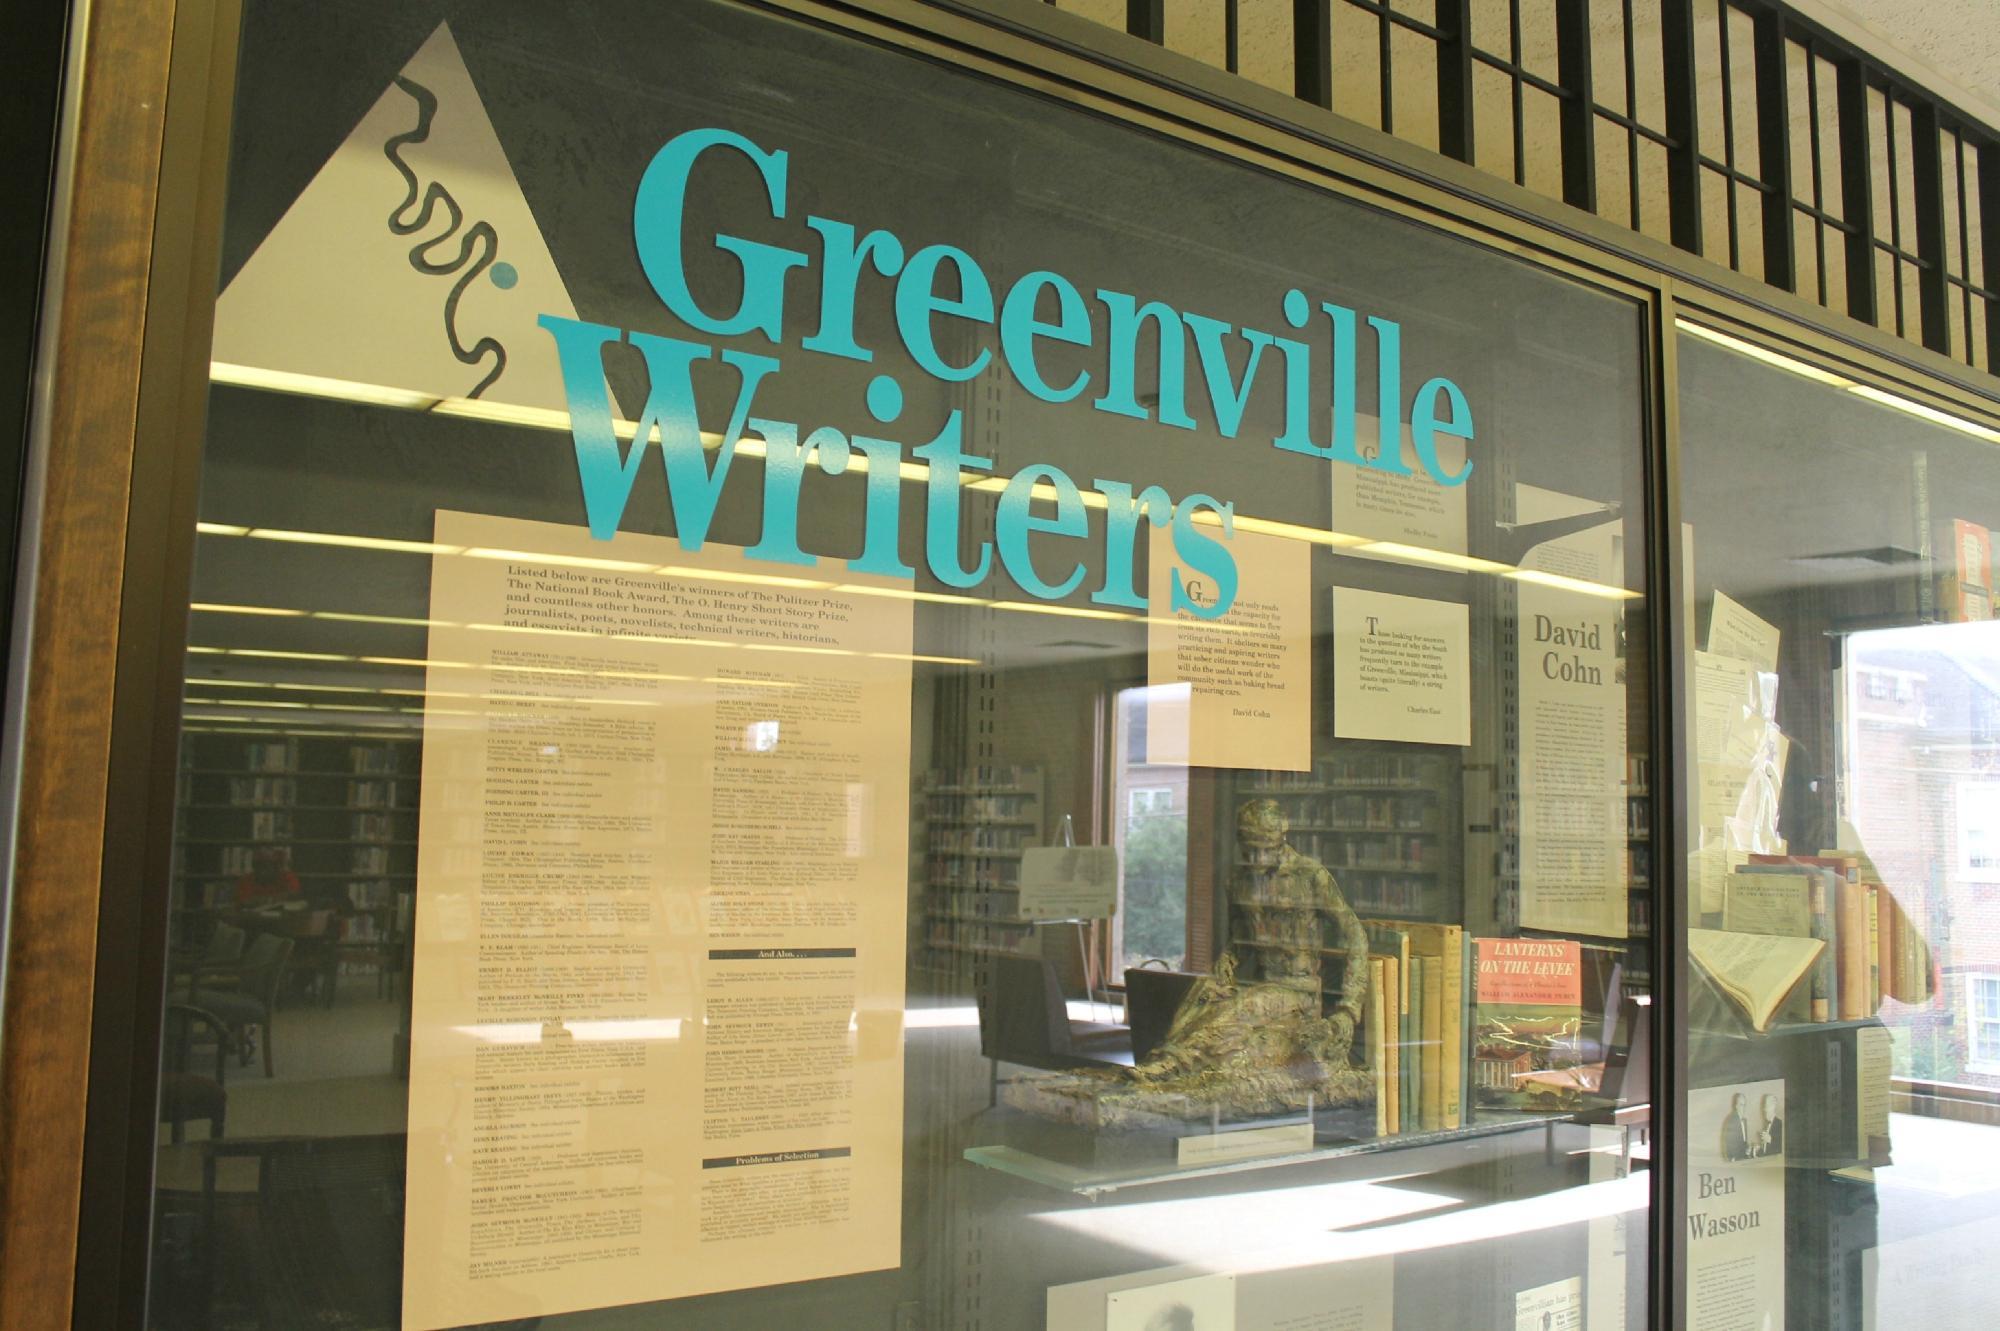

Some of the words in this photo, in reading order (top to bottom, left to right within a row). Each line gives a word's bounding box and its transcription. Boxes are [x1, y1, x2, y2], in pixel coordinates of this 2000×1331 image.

[634, 128, 1475, 487] Greenville
[537, 312, 1239, 620] Writers
[507, 578, 531, 589] The
[535, 581, 589, 595] National
[592, 587, 623, 599] Book
[628, 591, 670, 605] Award,
[672, 594, 694, 606] The
[697, 598, 710, 608] O.
[714, 600, 749, 613] Henry
[751, 603, 782, 615] Short
[785, 607, 815, 620] Story
[818, 610, 849, 622] Prize,
[508, 565, 548, 578] Listed
[551, 569, 589, 582] below
[591, 576, 611, 585] are
[615, 576, 685, 592] Greenville's
[689, 586, 735, 598] winners
[737, 591, 750, 600] of
[751, 591, 773, 602] The
[776, 594, 819, 607] Pulitzer
[822, 598, 853, 612] Prize,
[506, 592, 530, 602] and
[534, 595, 593, 609] countless
[596, 601, 629, 613] other
[632, 603, 677, 617] honors.
[683, 610, 723, 622] Among
[726, 614, 756, 625] these
[759, 618, 799, 630] writers
[801, 623, 819, 631] are
[504, 605, 578, 621] journalists,
[581, 612, 617, 625] poets,
[620, 616, 677, 630] novelists,
[680, 621, 732, 634] technical
[736, 627, 780, 640] writers,
[782, 631, 840, 646] historians,
[504, 618, 528, 628] and
[590, 626, 602, 635] in
[1534, 614, 1602, 650] David
[1177, 633, 1203, 643] writing
[1233, 638, 1260, 648] shelters
[1228, 648, 1256, 659] aspiring
[1257, 651, 1280, 660] writers
[1177, 653, 1192, 662] that
[1177, 663, 1191, 672] will
[1202, 665, 1214, 674] the
[1542, 651, 1603, 686] Cohn
[758, 950, 775, 958] And
[1494, 942, 1565, 957] LANTERNS
[1480, 960, 1502, 973] ON
[1504, 961, 1531, 974] THE
[1533, 962, 1576, 976] LEVEE
[735, 1155, 773, 1165] Problems
[774, 1154, 783, 1163] of
[784, 1151, 819, 1161] Selection
[1698, 1172, 1736, 1199] Ben
[1689, 1210, 1760, 1241] Wasson
